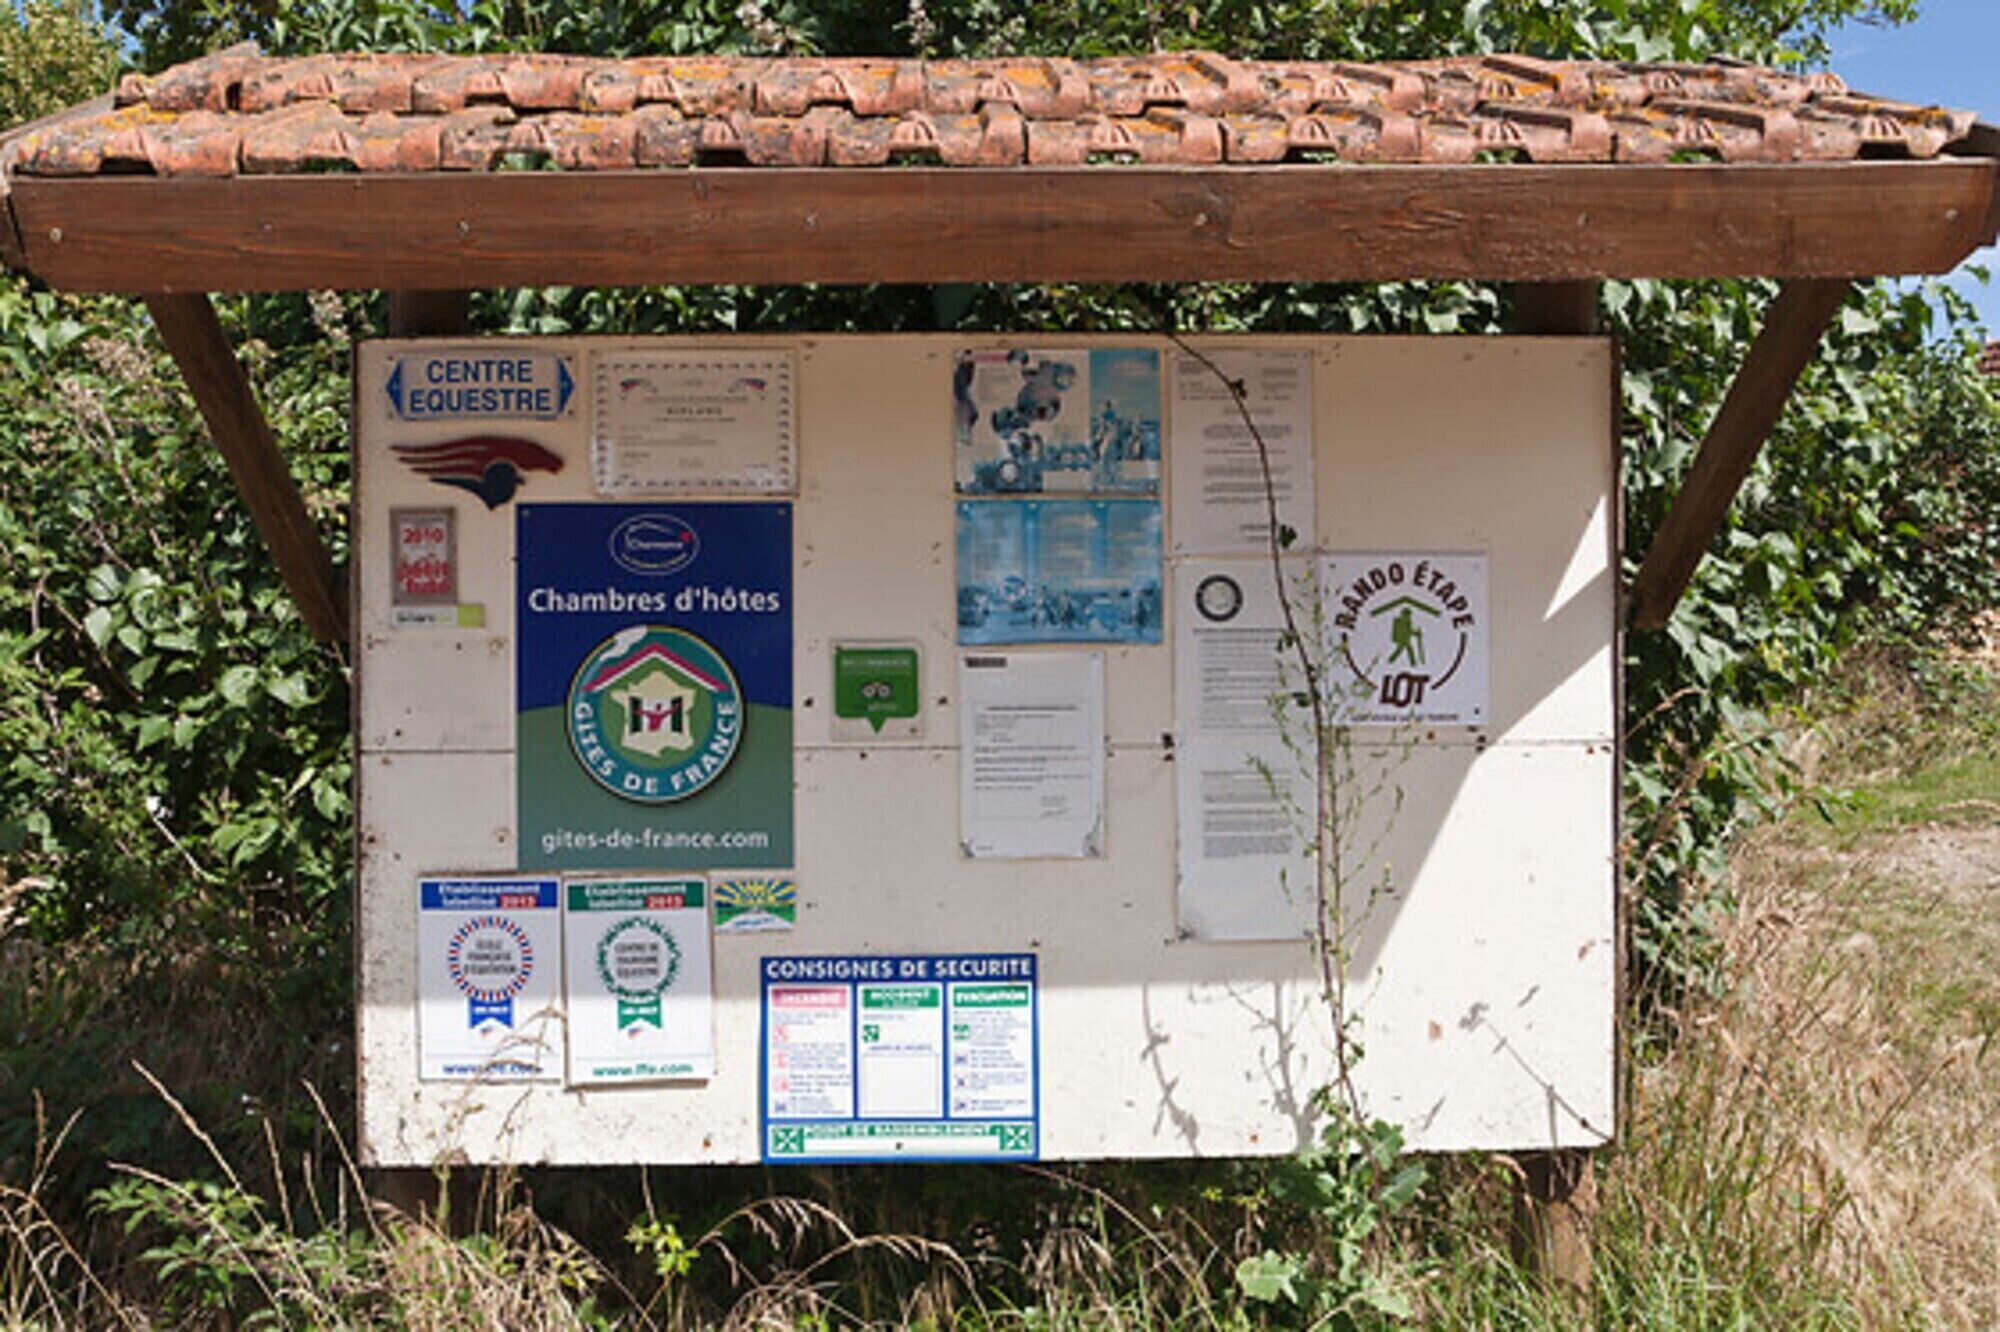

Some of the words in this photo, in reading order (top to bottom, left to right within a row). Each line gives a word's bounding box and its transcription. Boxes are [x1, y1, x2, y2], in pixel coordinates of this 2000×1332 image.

[427, 360, 533, 383] CENTRE
[410, 388, 551, 413] EQUESTRE
[528, 587, 666, 612] Chambres
[674, 587, 780, 612] d'hôtes
[1334, 562, 1404, 630] RANDO
[1413, 560, 1475, 629] ÉTAPE
[1379, 671, 1430, 708] LOT
[623, 774, 658, 794] DE
[670, 701, 737, 791] FRANCE
[541, 829, 769, 853] gites-de-france.com
[767, 959, 893, 979] CONSIGNES
[900, 959, 926, 978] DE
[935, 958, 1031, 977] SECURITE
